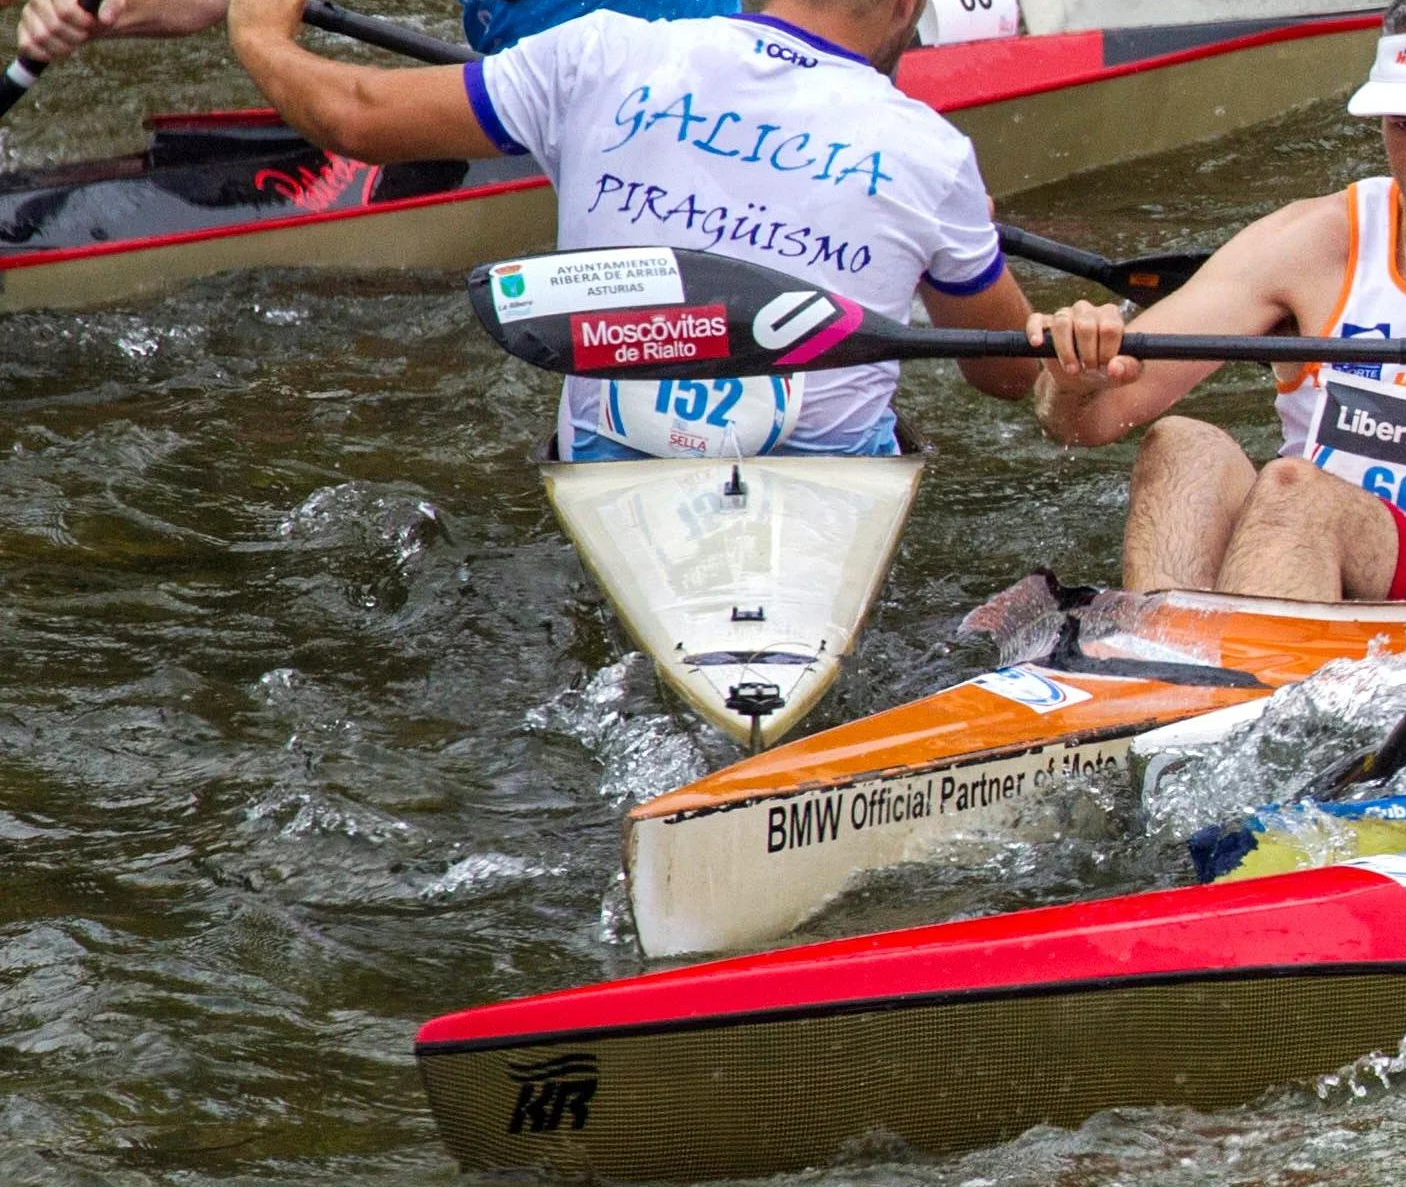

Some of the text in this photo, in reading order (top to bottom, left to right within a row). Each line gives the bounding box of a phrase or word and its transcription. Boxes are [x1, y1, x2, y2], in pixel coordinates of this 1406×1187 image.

[602, 85, 894, 197] GALICIA
[589, 174, 874, 274] PIRAGÜISMO
[550, 266, 677, 287] RIBERA DE ARRIBA
[557, 258, 668, 275] AYUNTAMIENTO
[587, 283, 645, 297] ASTURIAS
[582, 312, 727, 349] Moscovitas
[615, 340, 697, 364] de Rialto
[655, 376, 744, 428] 152
[669, 433, 707, 452] SELLA
[768, 794, 843, 855] BMW
[850, 776, 932, 831] Official
[940, 770, 1027, 816] Partner
[1034, 757, 1056, 788] of
[509, 1078, 598, 1134] KR
